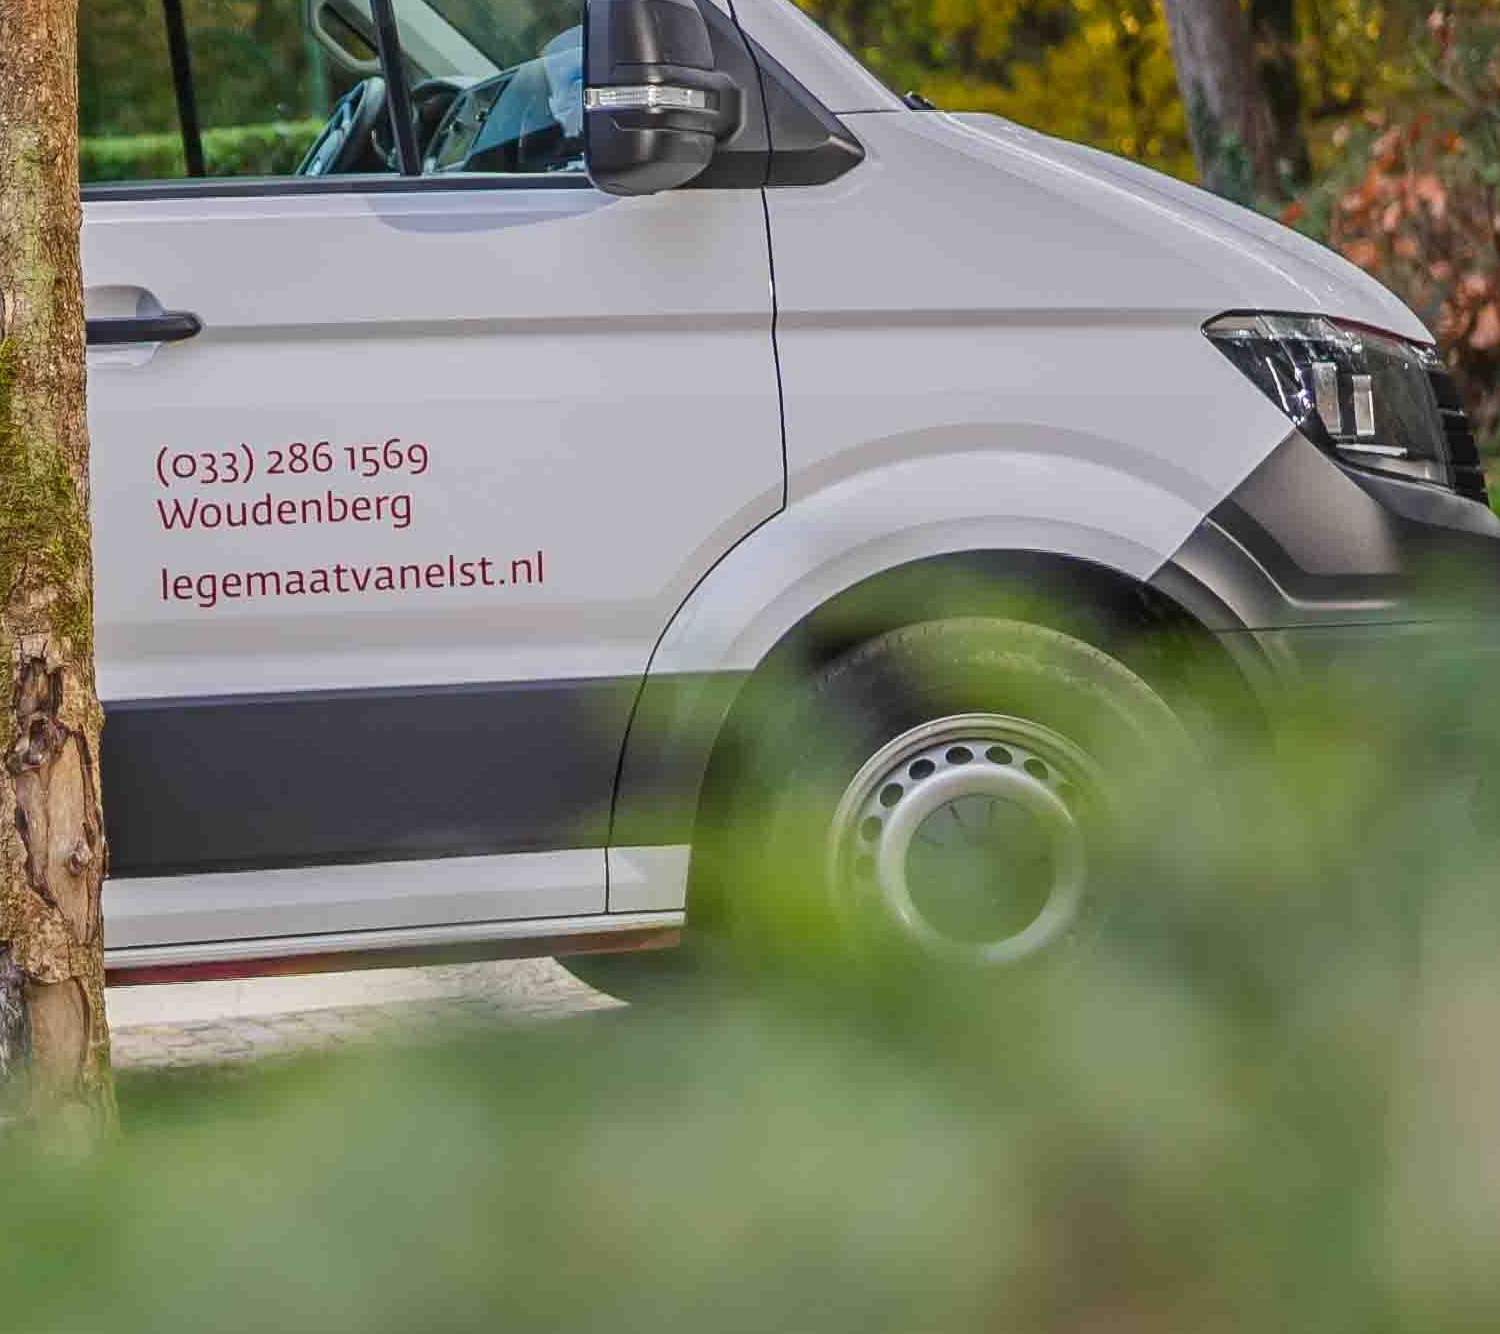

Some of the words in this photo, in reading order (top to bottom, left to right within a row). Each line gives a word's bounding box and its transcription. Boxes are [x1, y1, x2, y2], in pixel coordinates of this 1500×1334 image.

[156, 443, 255, 487] (033)
[266, 442, 333, 475] 286
[343, 439, 429, 477] 1569
[157, 491, 412, 530] Woudenberg
[161, 551, 545, 608] legemaatvanelst.nl
